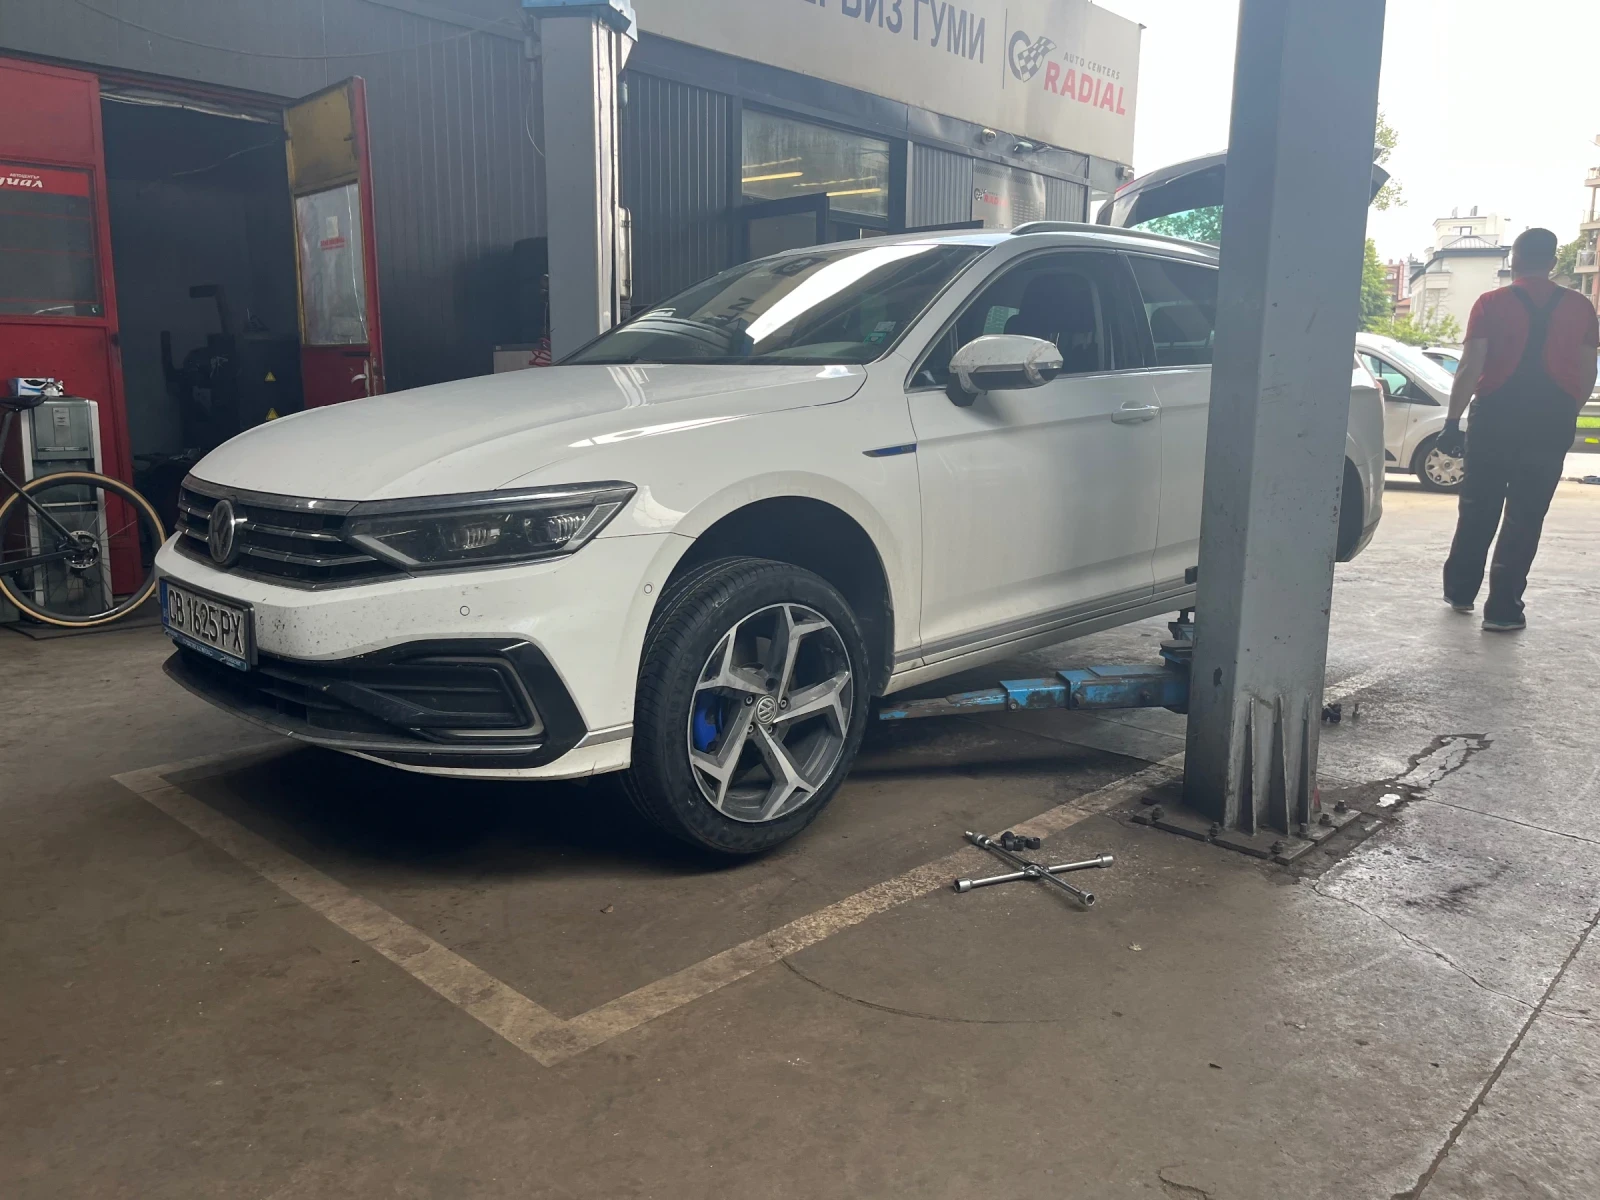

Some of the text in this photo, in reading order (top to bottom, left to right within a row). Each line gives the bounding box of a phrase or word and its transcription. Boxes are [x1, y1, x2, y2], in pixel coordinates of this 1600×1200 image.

[913, 0, 986, 64] ГУМИ
[1043, 60, 1126, 116] RADIAL
[1063, 52, 1121, 80] AUTO CENTERS
